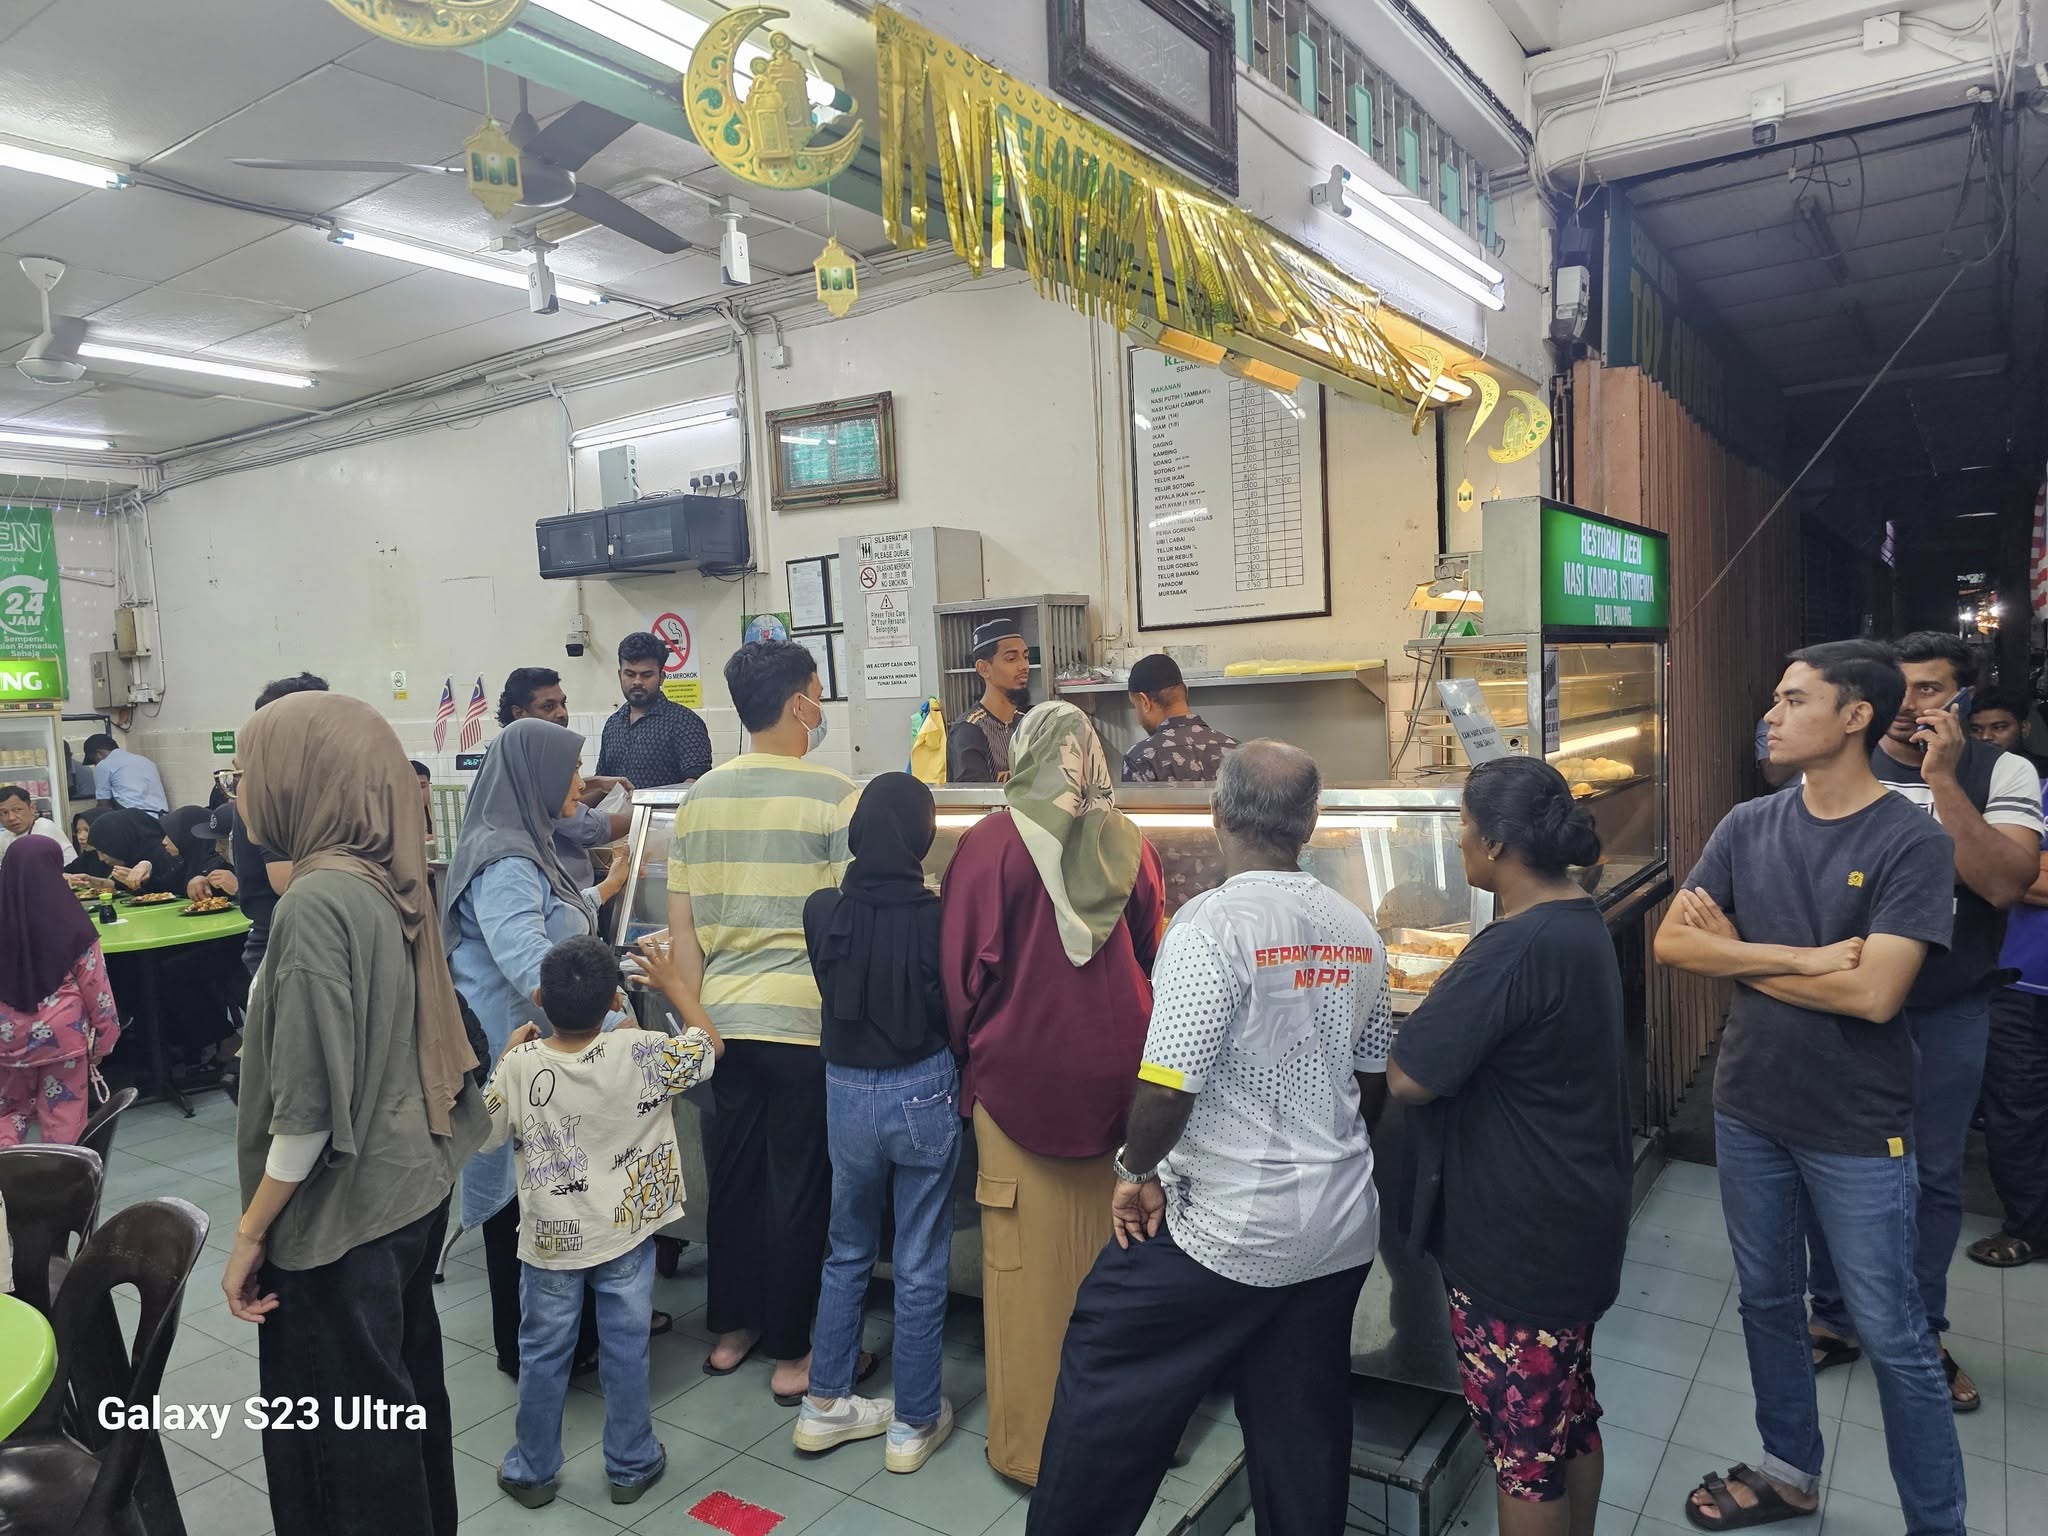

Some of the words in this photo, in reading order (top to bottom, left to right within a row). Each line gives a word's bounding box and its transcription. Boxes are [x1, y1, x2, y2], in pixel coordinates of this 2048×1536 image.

[997, 103, 1134, 220] SELAMAT
[1151, 383, 1181, 393] MAKANAN
[1164, 395, 1180, 403] PUTIH
[1184, 389, 1207, 398] TAMBAH
[1180, 399, 1204, 408] CAMPUR
[1153, 441, 1173, 449] DAGING
[1153, 449, 1177, 457] KAMBING
[1153, 458, 1172, 466] UDANG
[1154, 467, 1176, 475] SOTONG
[1154, 485, 1171, 493] TELUR
[1172, 481, 1195, 490] SOTONG
[1155, 493, 1175, 501] KEPALA
[1172, 526, 1196, 534] GORENG
[874, 536, 885, 544] SILA
[886, 533, 908, 543] BERATUR
[1581, 522, 1622, 561] RESTORAN
[1623, 534, 1642, 565] DEEN
[874, 550, 892, 559] PLEASE
[893, 549, 910, 557] QUEUE
[1157, 563, 1174, 571] TELUR
[889, 578, 908, 587] SMOKING
[1564, 561, 1584, 596] NASI
[1588, 565, 1618, 599] KANDAR
[1620, 571, 1654, 602] ISTIMEWA
[1159, 589, 1187, 597] MURTABAK
[5, 592, 45, 615] 24
[1595, 604, 1613, 625] PULAU
[1613, 605, 1632, 626] PINANG
[8, 616, 41, 626] JAM
[876, 626, 898, 634] Belongings
